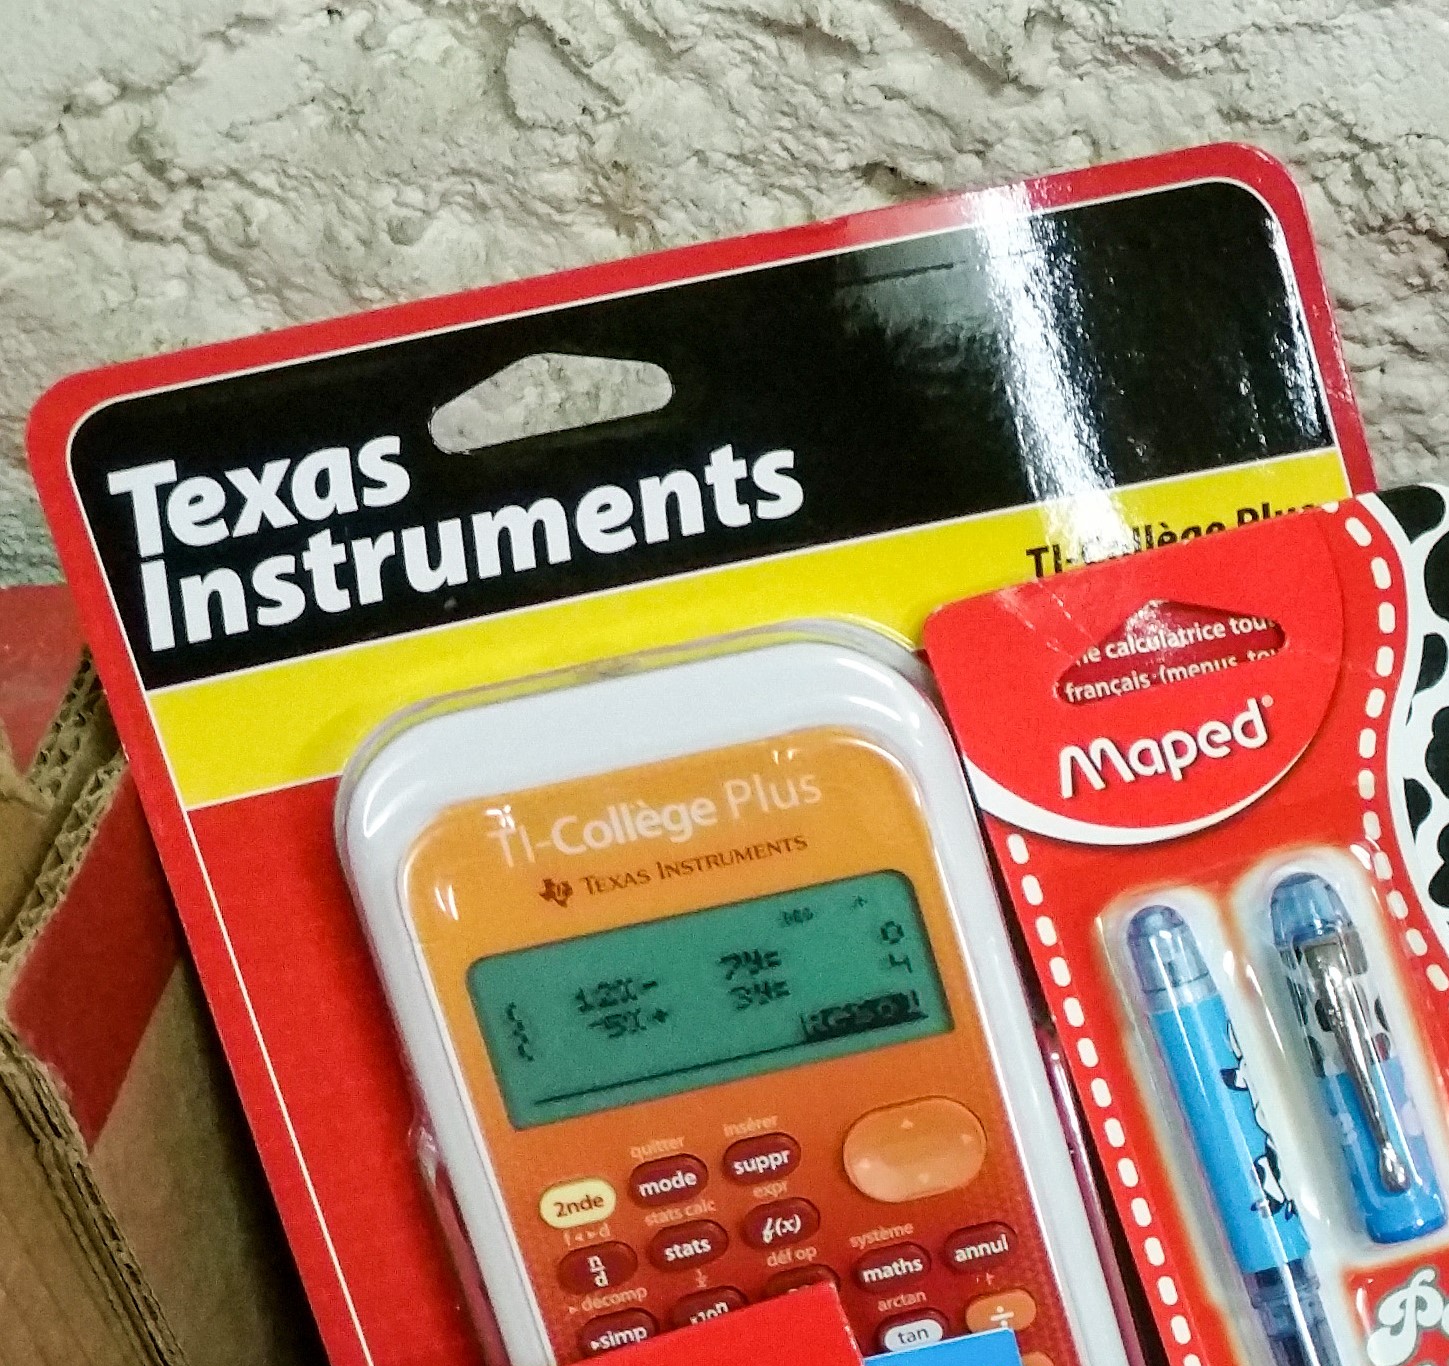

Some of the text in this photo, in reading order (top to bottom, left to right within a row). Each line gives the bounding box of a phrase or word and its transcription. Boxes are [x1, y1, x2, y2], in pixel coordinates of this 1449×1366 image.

[108, 435, 410, 559] Texas
[144, 444, 804, 652] Instruments
[1105, 622, 1227, 661] calculatrice
[1061, 670, 1154, 704] français
[1058, 698, 1268, 801] Maped
[487, 771, 822, 867] TI-Collège Plus
[580, 835, 809, 897] TEXAS INSTRUMENTS
[733, 1146, 791, 1177] suppr
[638, 1169, 698, 1198] mode
[552, 1193, 606, 1218] 2nde
[664, 1236, 712, 1263] stats
[849, 1222, 915, 1250] système
[954, 1234, 1010, 1263] annul
[862, 1252, 924, 1283] maths
[877, 1289, 928, 1312] arctan
[898, 1325, 929, 1346] tan
